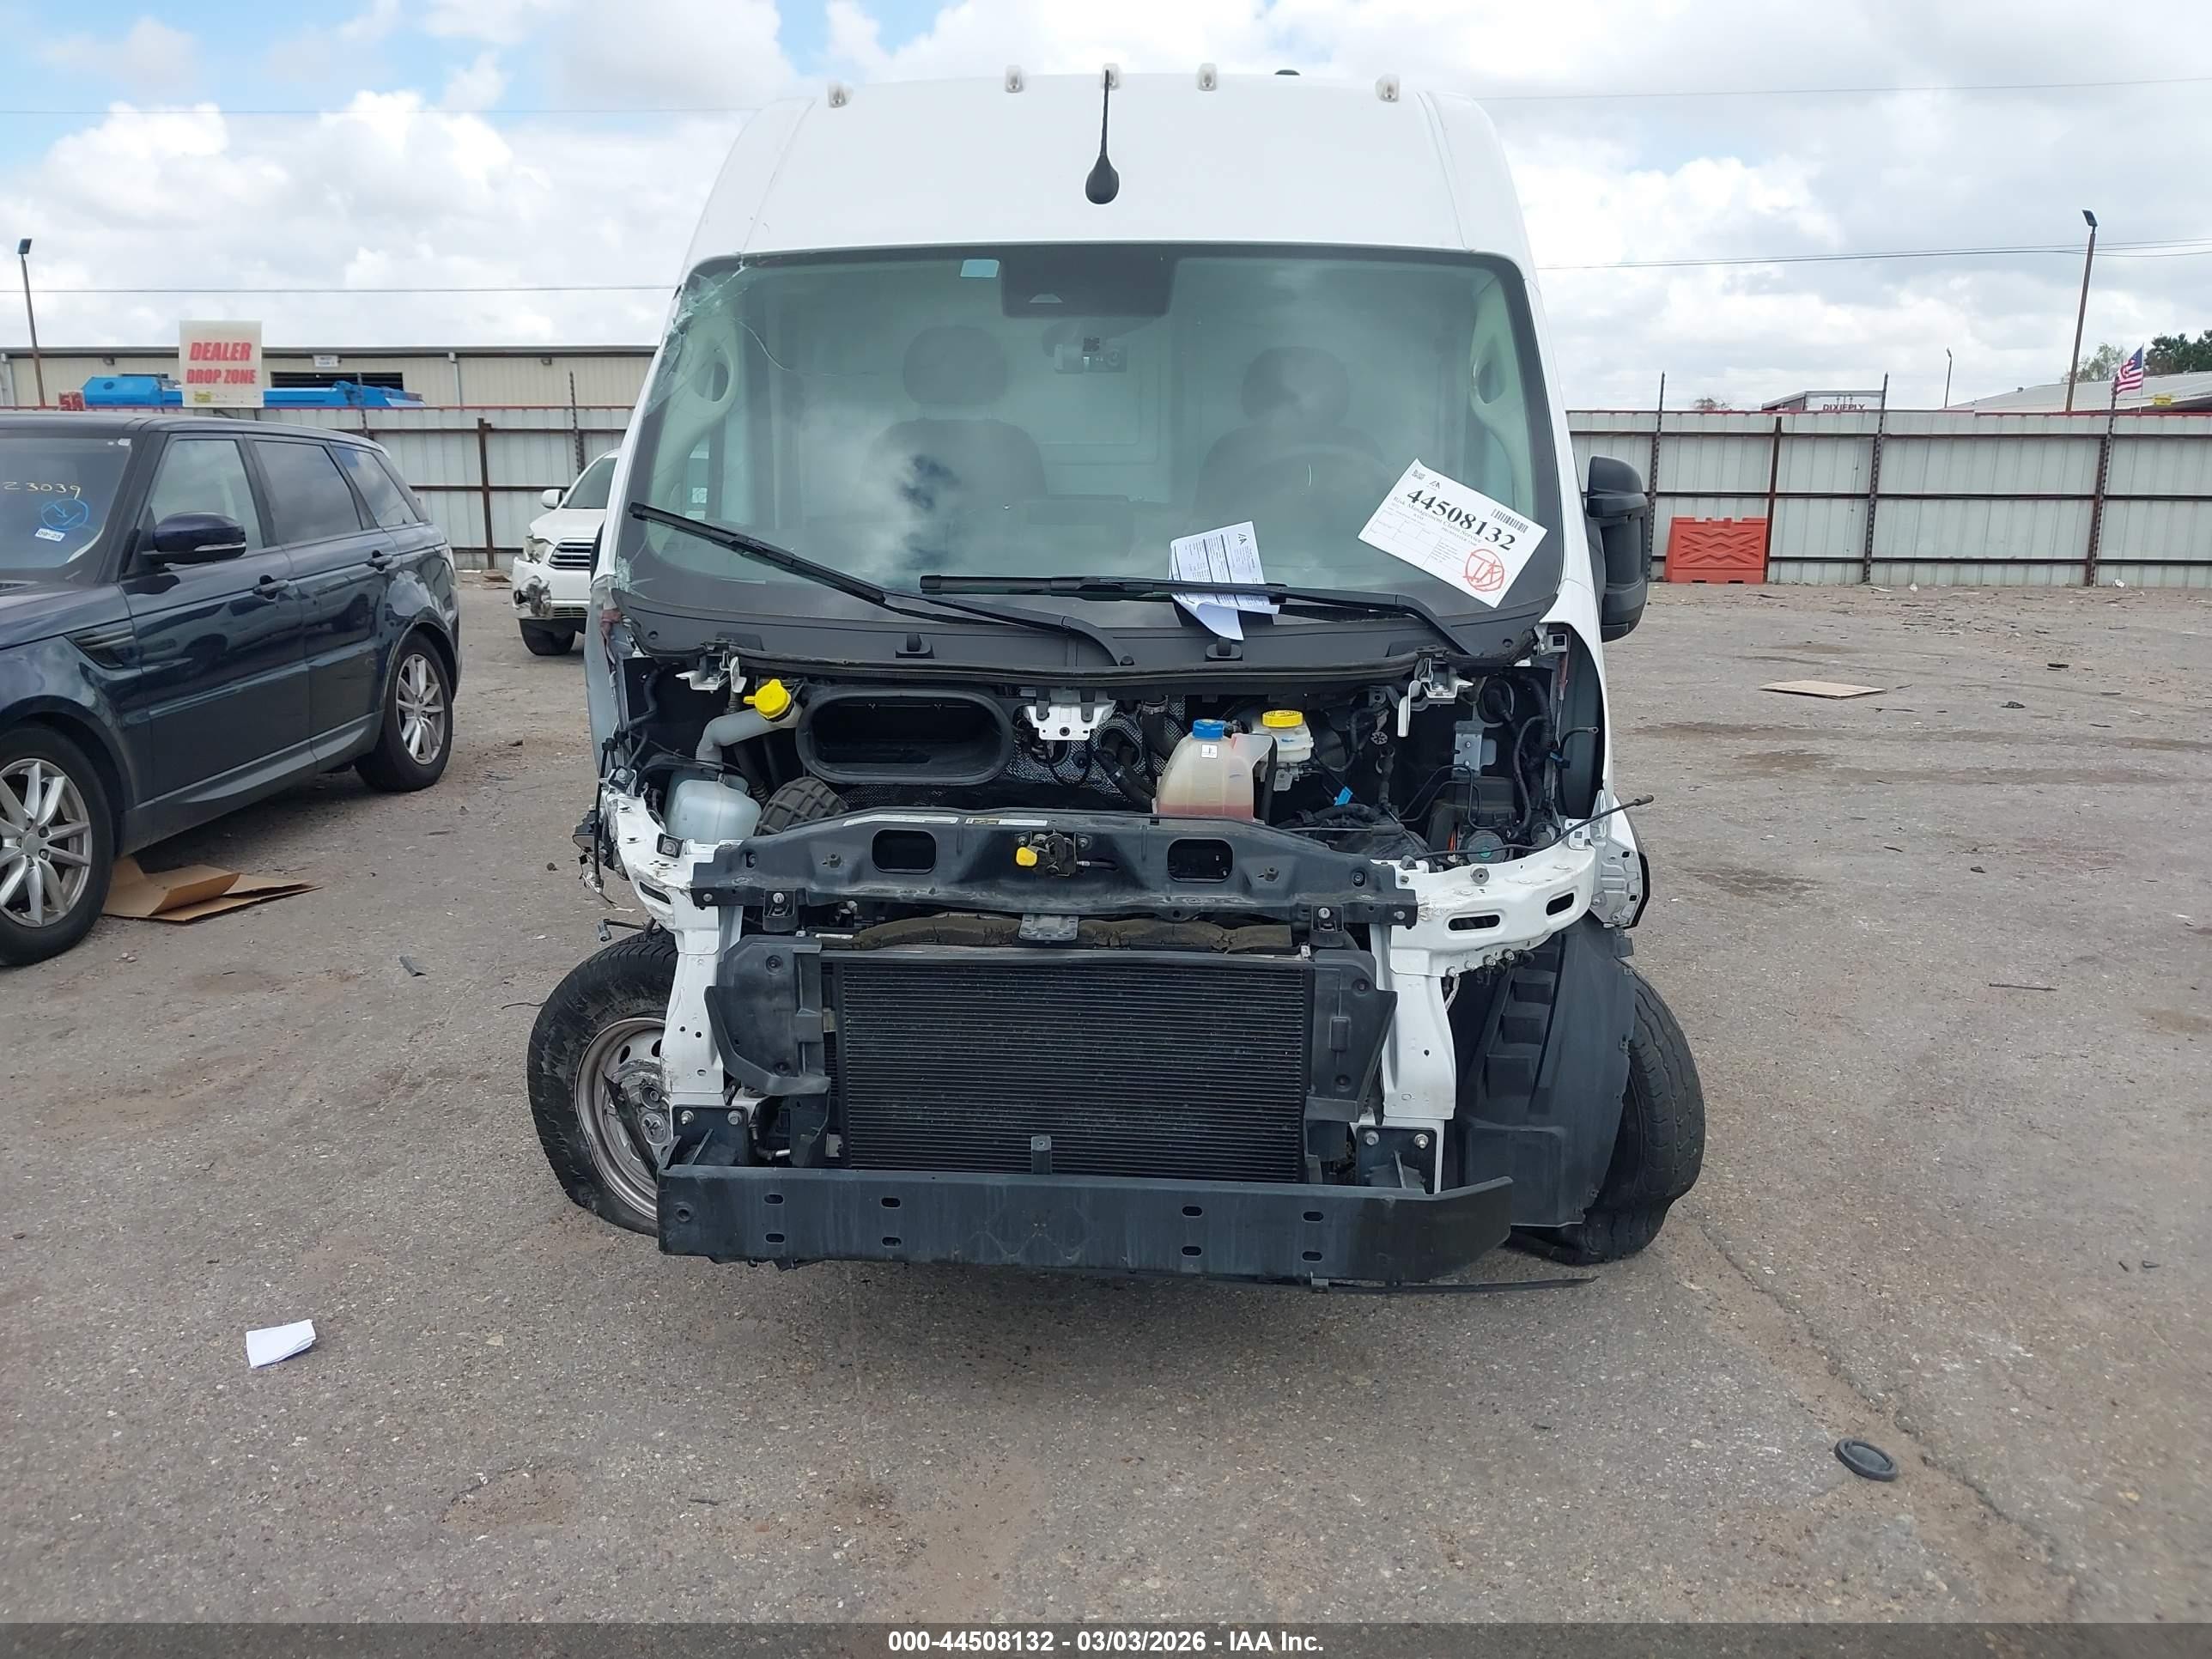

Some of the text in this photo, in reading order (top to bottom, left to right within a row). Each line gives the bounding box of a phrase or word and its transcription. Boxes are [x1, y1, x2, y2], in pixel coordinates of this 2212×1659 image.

[189, 342, 252, 362] DEALER
[186, 368, 256, 384] DROP ZONE
[1407, 490, 1516, 551] 44508132
